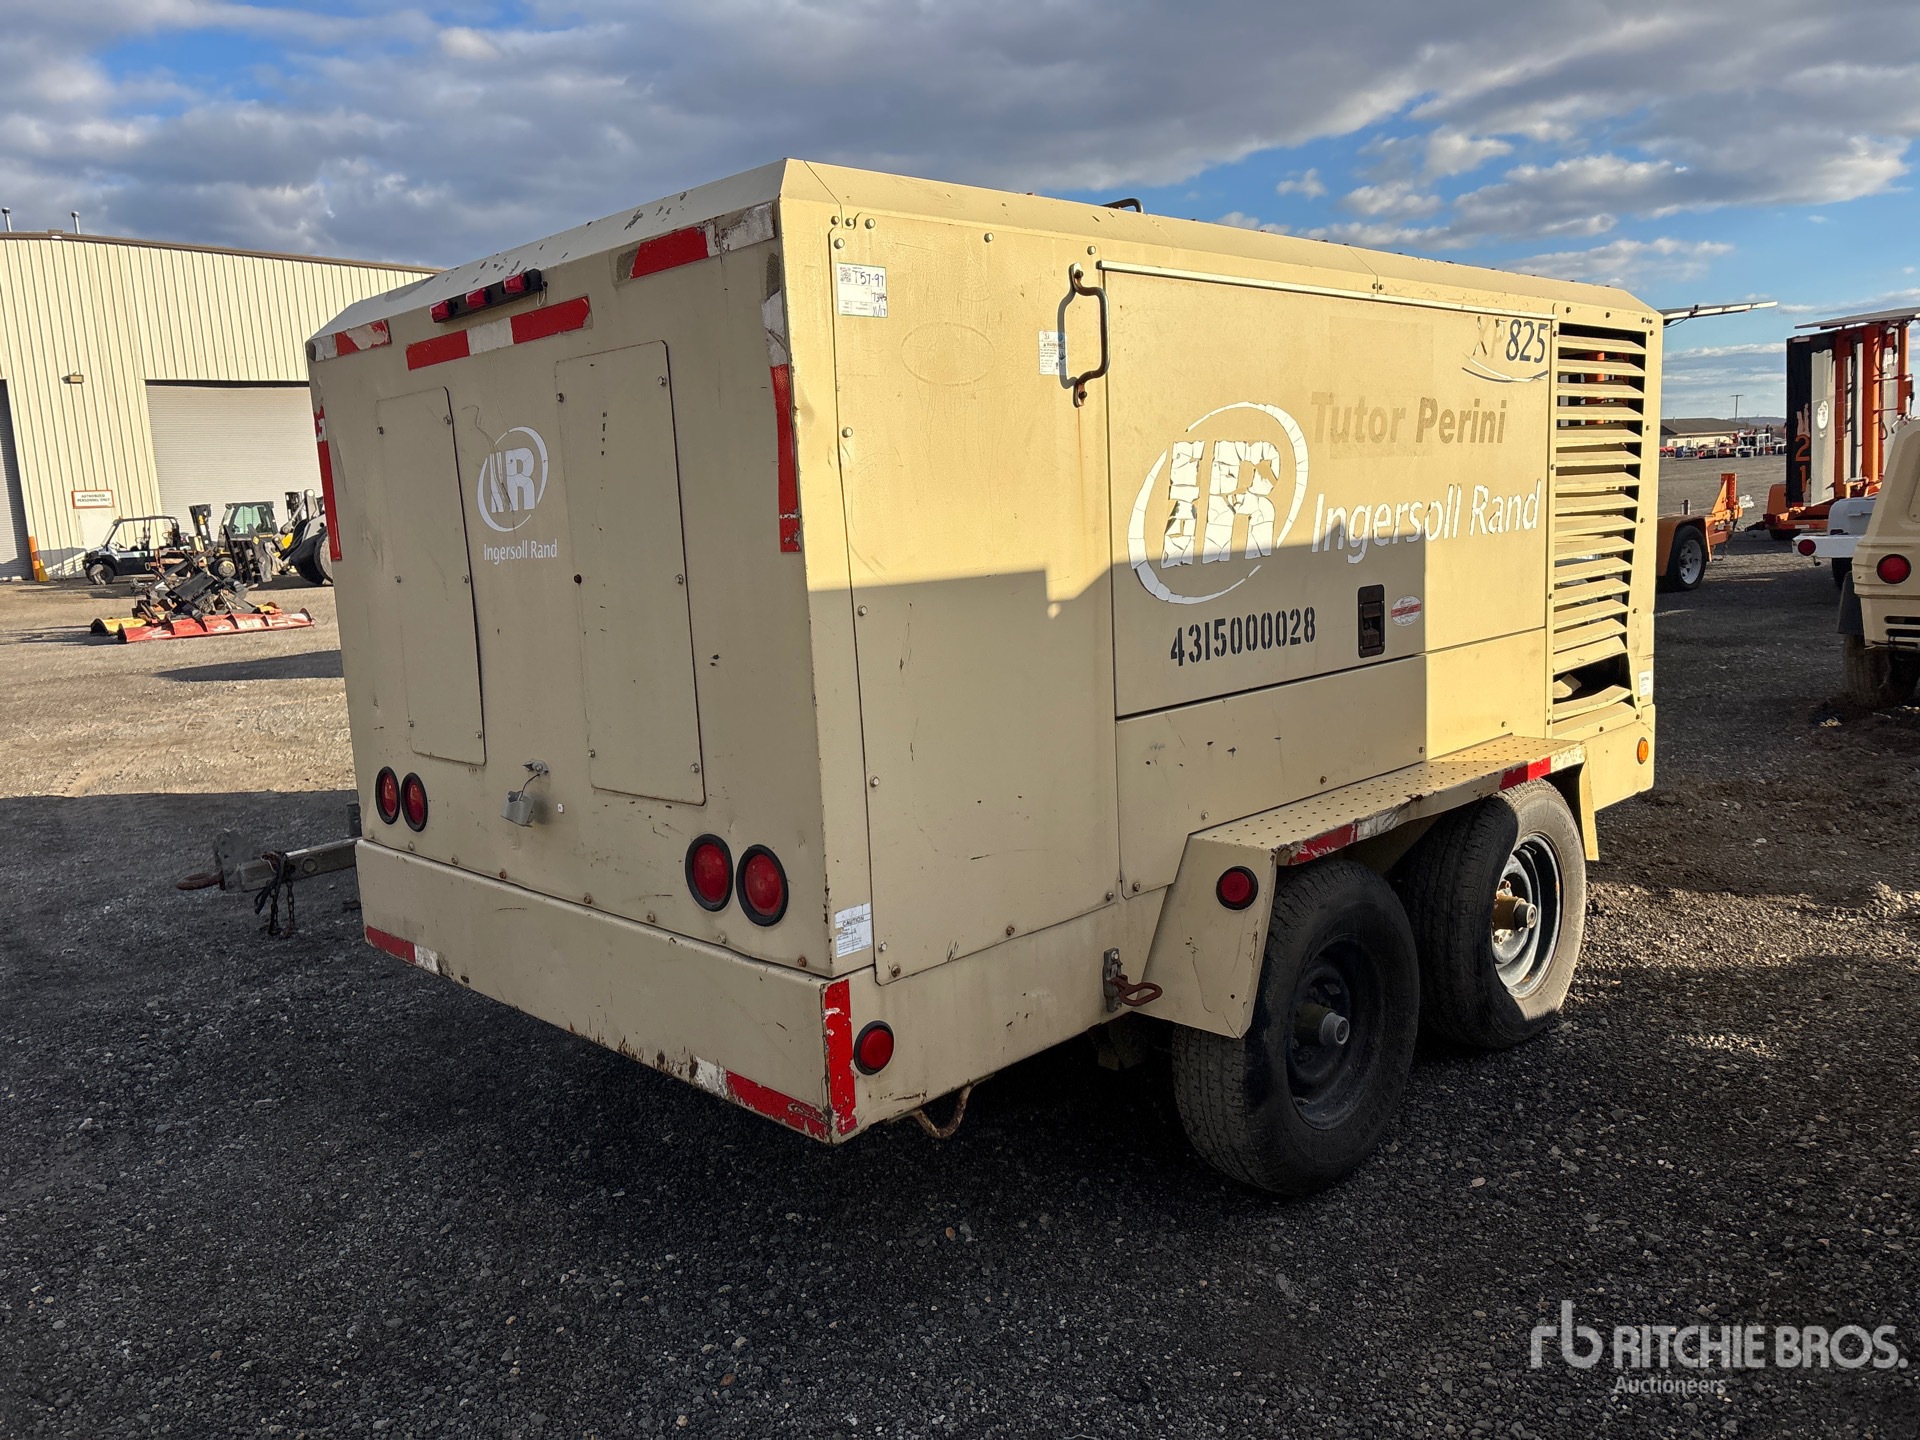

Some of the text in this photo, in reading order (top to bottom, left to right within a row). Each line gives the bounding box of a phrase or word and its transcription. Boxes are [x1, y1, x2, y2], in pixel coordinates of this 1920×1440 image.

[1311, 391, 1507, 444] Tutor Perini
[1160, 440, 1281, 569] IR
[1311, 478, 1542, 564] Ingersoll Rand
[483, 538, 558, 565] Ingersoll Rand
[1170, 606, 1316, 667] 4315000028
